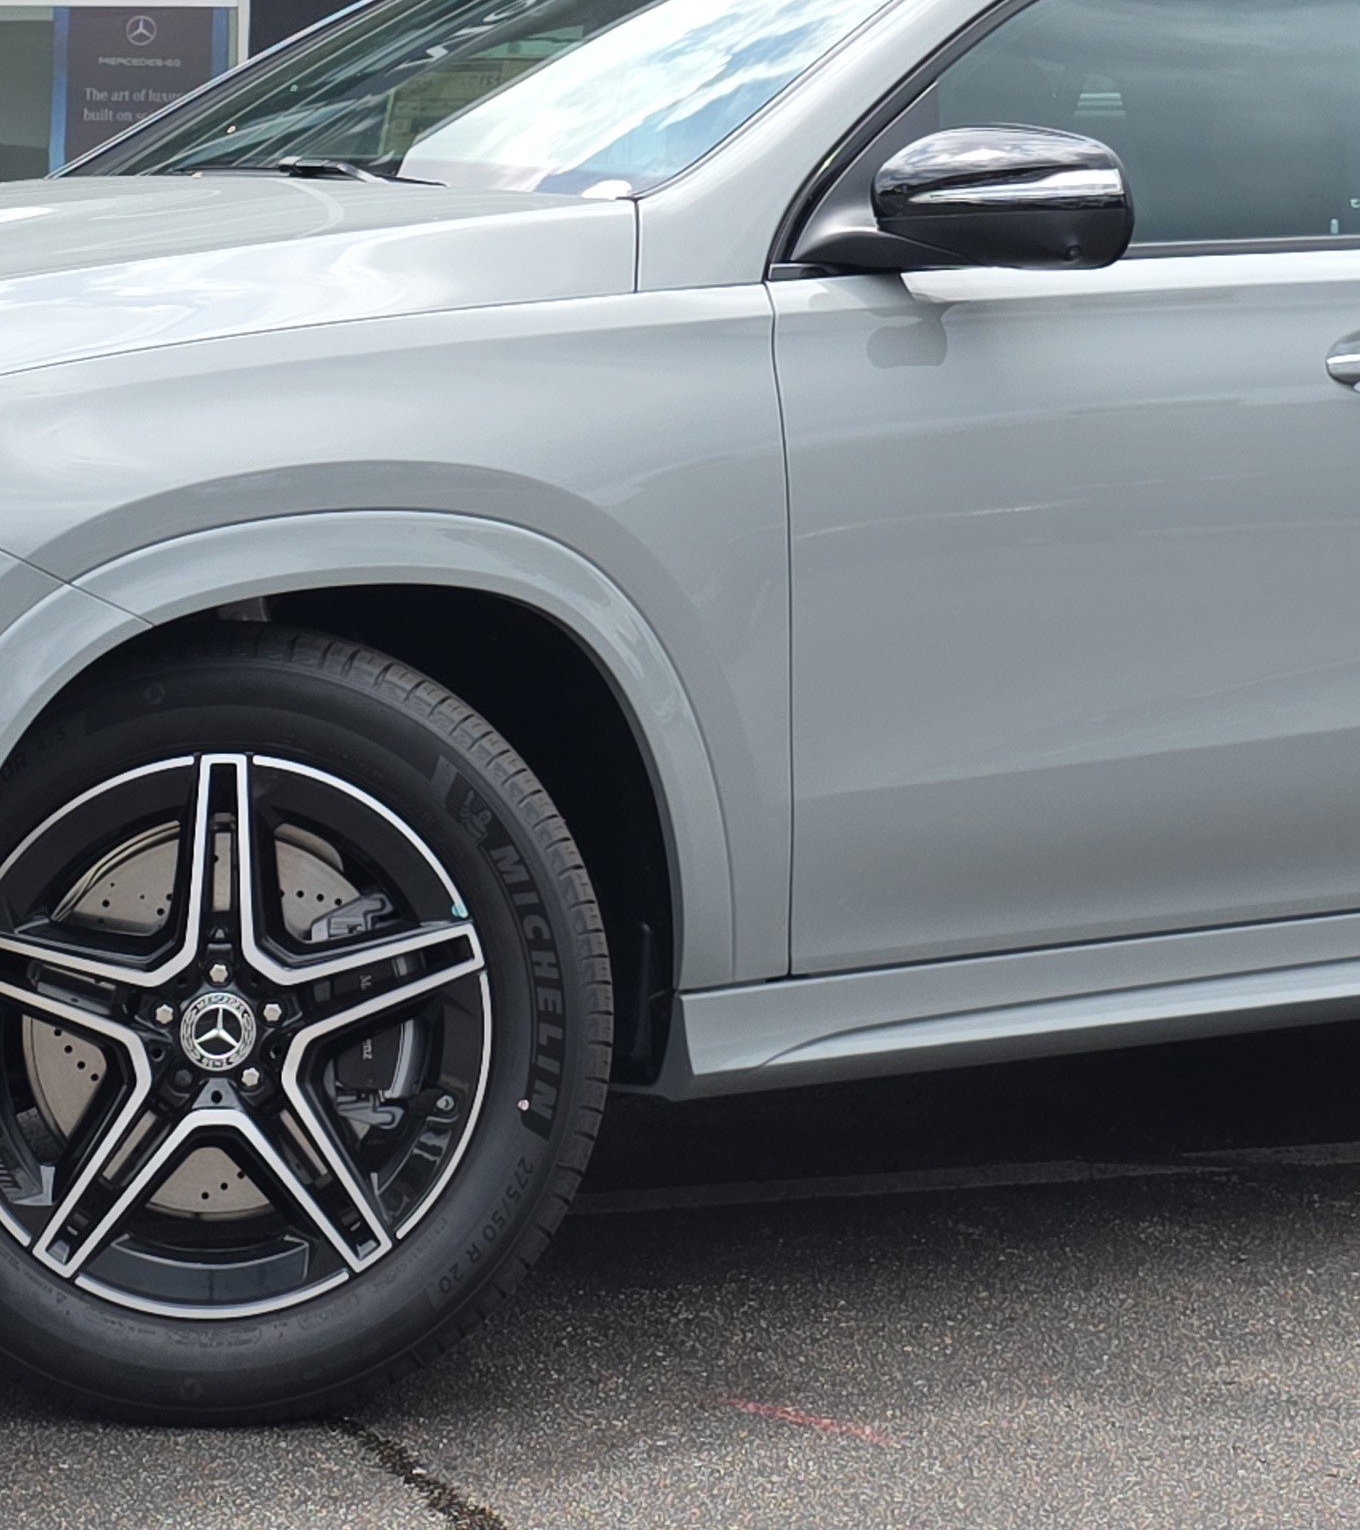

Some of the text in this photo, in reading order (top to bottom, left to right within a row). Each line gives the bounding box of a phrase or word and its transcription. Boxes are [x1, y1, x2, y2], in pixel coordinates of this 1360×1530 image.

[83, 107, 113, 122] built
[116, 110, 133, 122] on
[84, 88, 108, 102] The
[111, 89, 129, 102] art
[132, 88, 147, 102] of
[488, 843, 565, 1120] MICHELIN
[437, 1155, 535, 1295] 275/50 R 20
